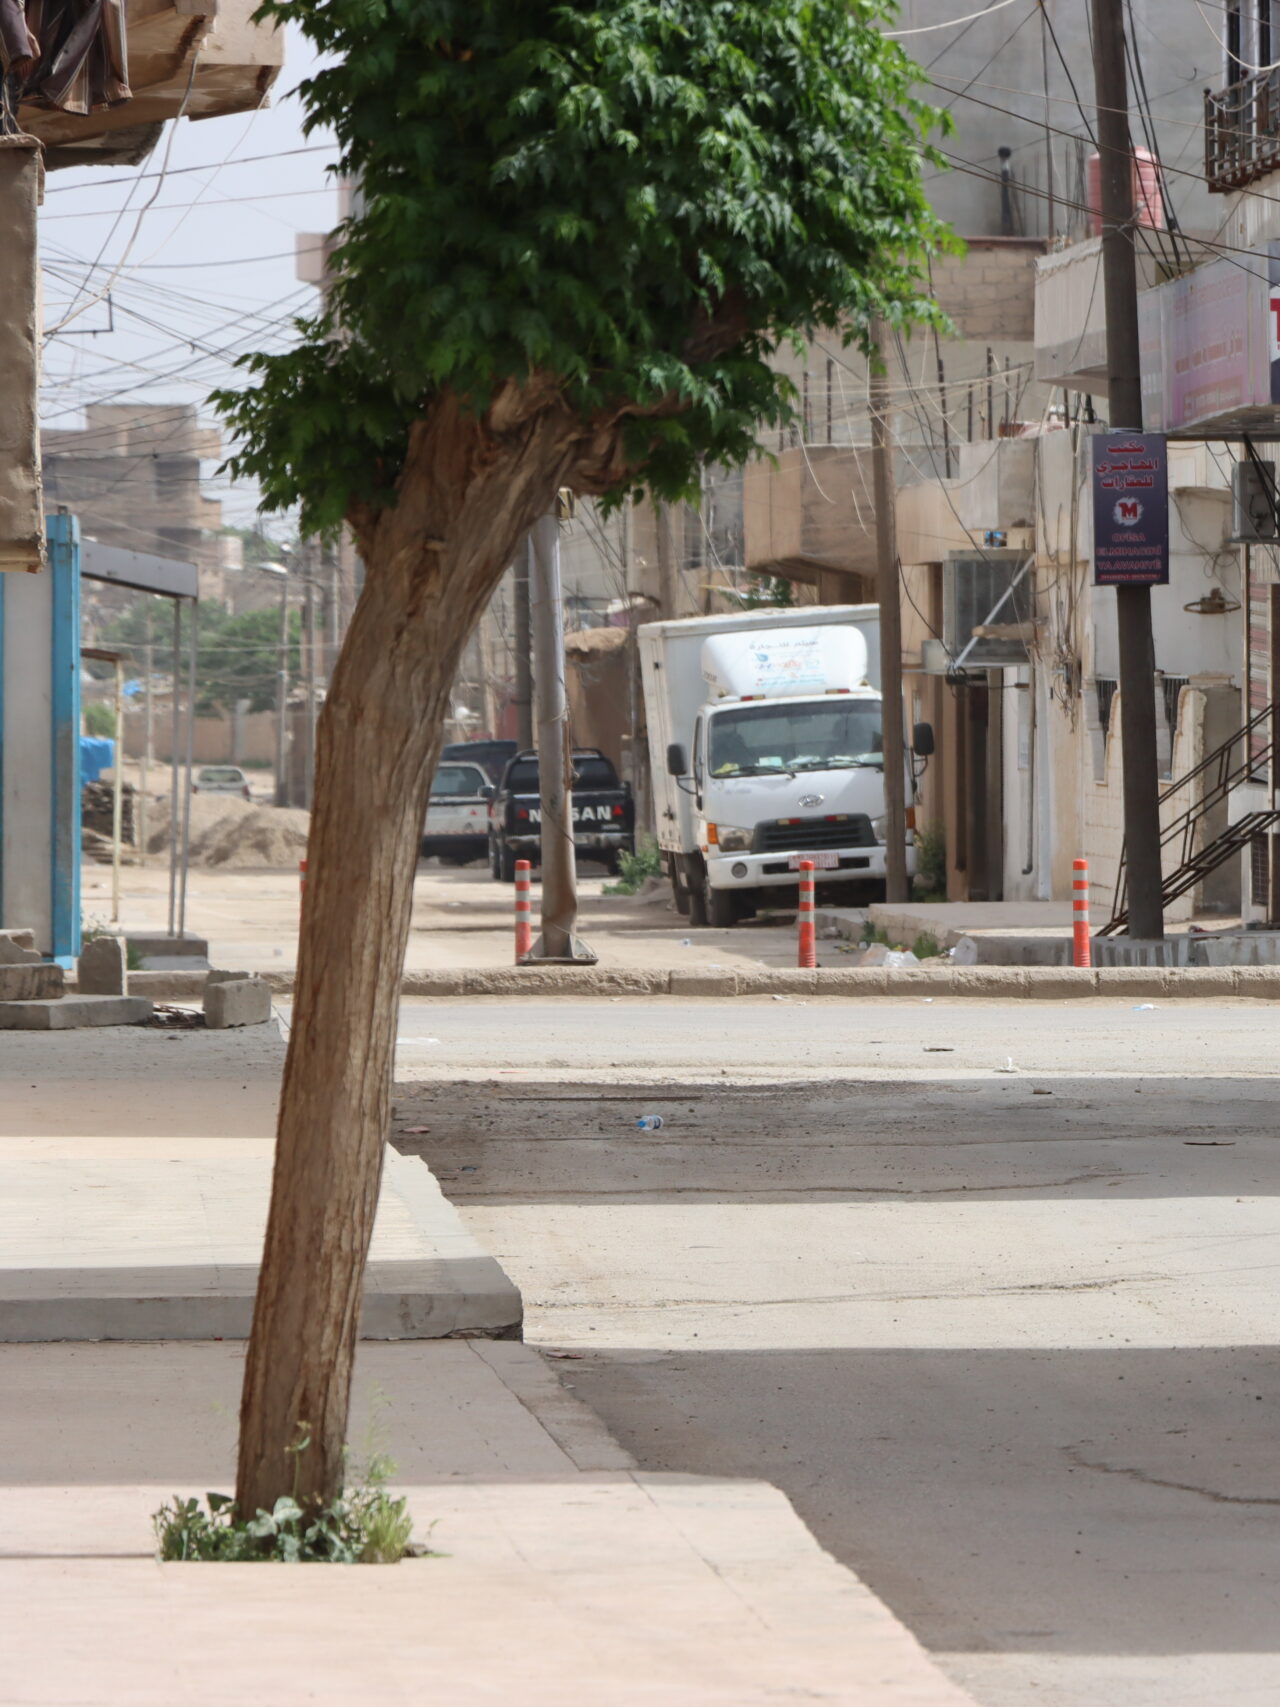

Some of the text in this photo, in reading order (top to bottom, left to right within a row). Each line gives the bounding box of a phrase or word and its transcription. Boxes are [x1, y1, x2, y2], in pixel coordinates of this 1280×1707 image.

[1107, 440, 1146, 455] مكتب
[1096, 457, 1160, 478] المهاجري
[1101, 475, 1154, 491] للعقارات
[528, 805, 613, 823] NSAN
